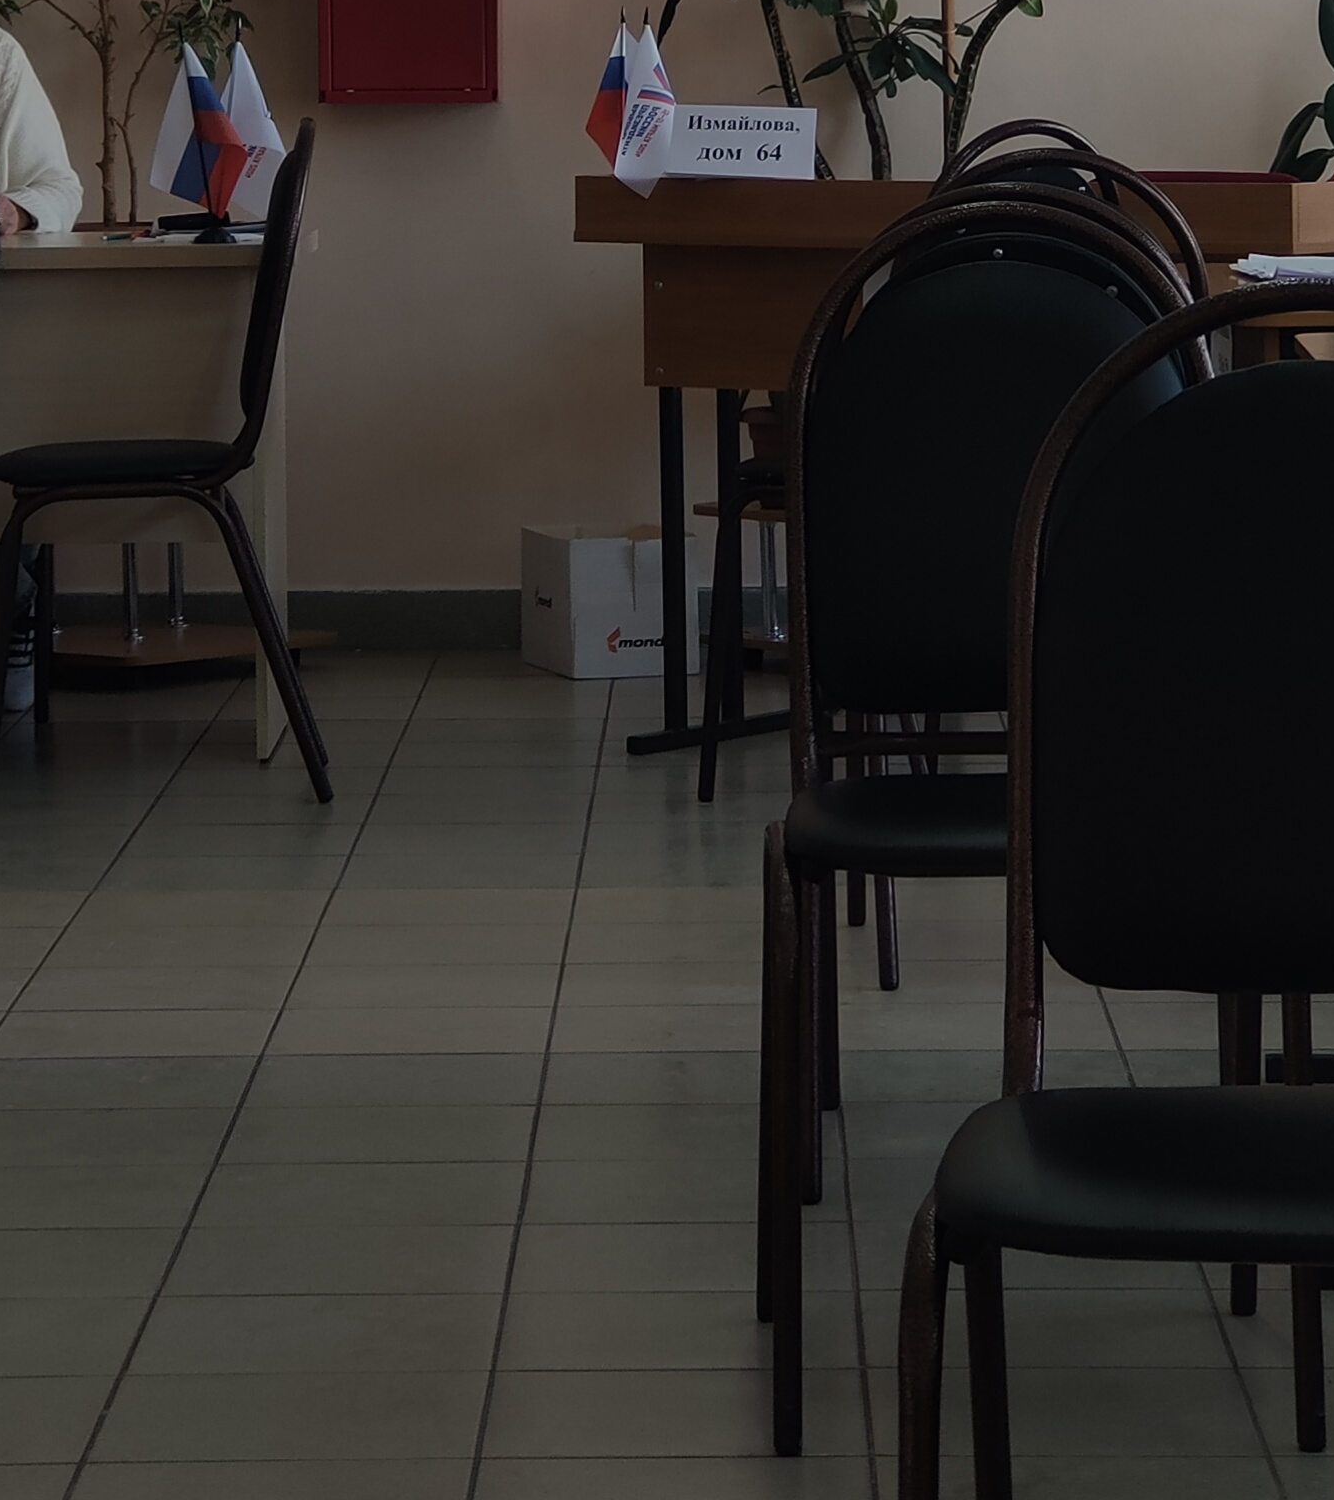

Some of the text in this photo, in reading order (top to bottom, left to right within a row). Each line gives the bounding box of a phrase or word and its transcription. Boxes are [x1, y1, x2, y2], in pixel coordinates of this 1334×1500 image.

[688, 114, 801, 135] Измайлова,
[696, 143, 782, 162] дом 64
